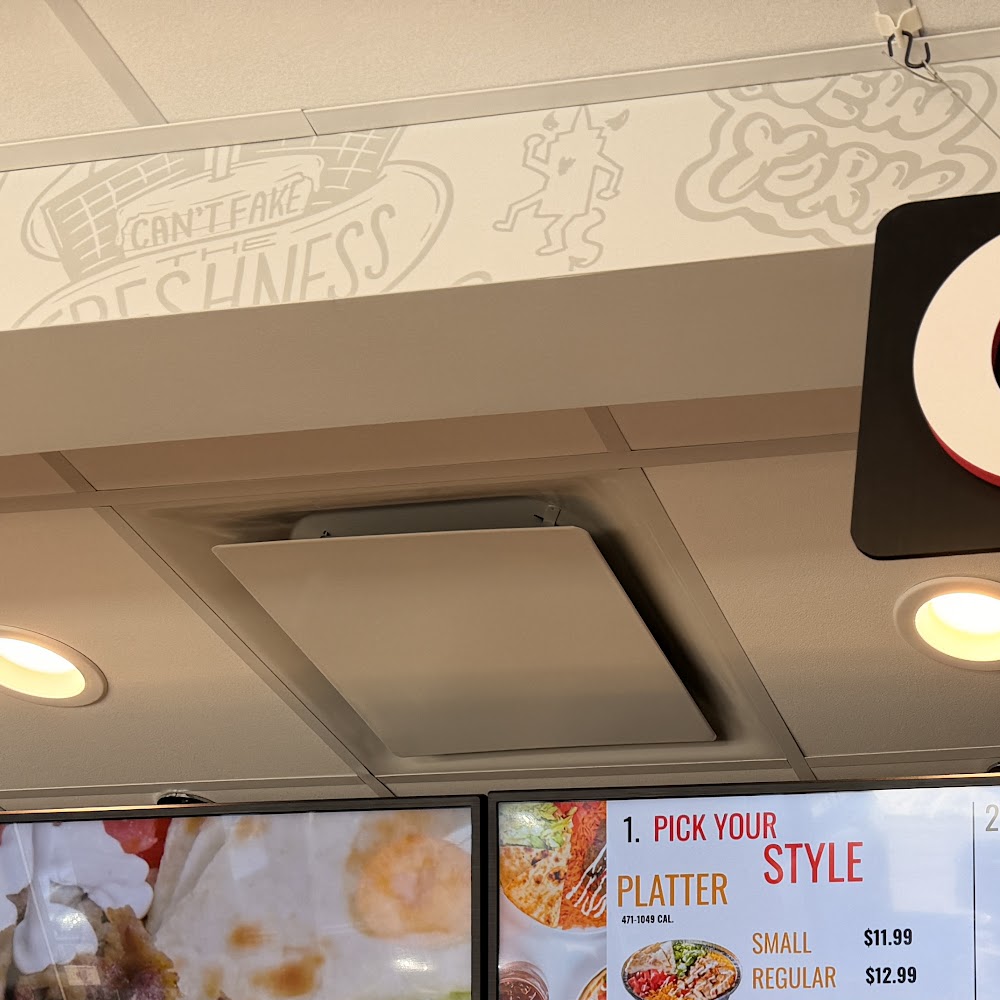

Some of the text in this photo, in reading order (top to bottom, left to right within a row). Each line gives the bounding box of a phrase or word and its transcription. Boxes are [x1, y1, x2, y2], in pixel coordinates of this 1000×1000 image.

[130, 178, 305, 249] CAN'T FAKE
[155, 236, 278, 267] THE
[623, 811, 777, 843] 1. PICK YOUR
[763, 841, 864, 885] STYLE
[617, 872, 729, 908] PLATTER
[621, 914, 674, 925] 471-1049 CAL.
[752, 927, 913, 954] SMALL $11.99
[752, 966, 917, 990] REGULAR $12.99
